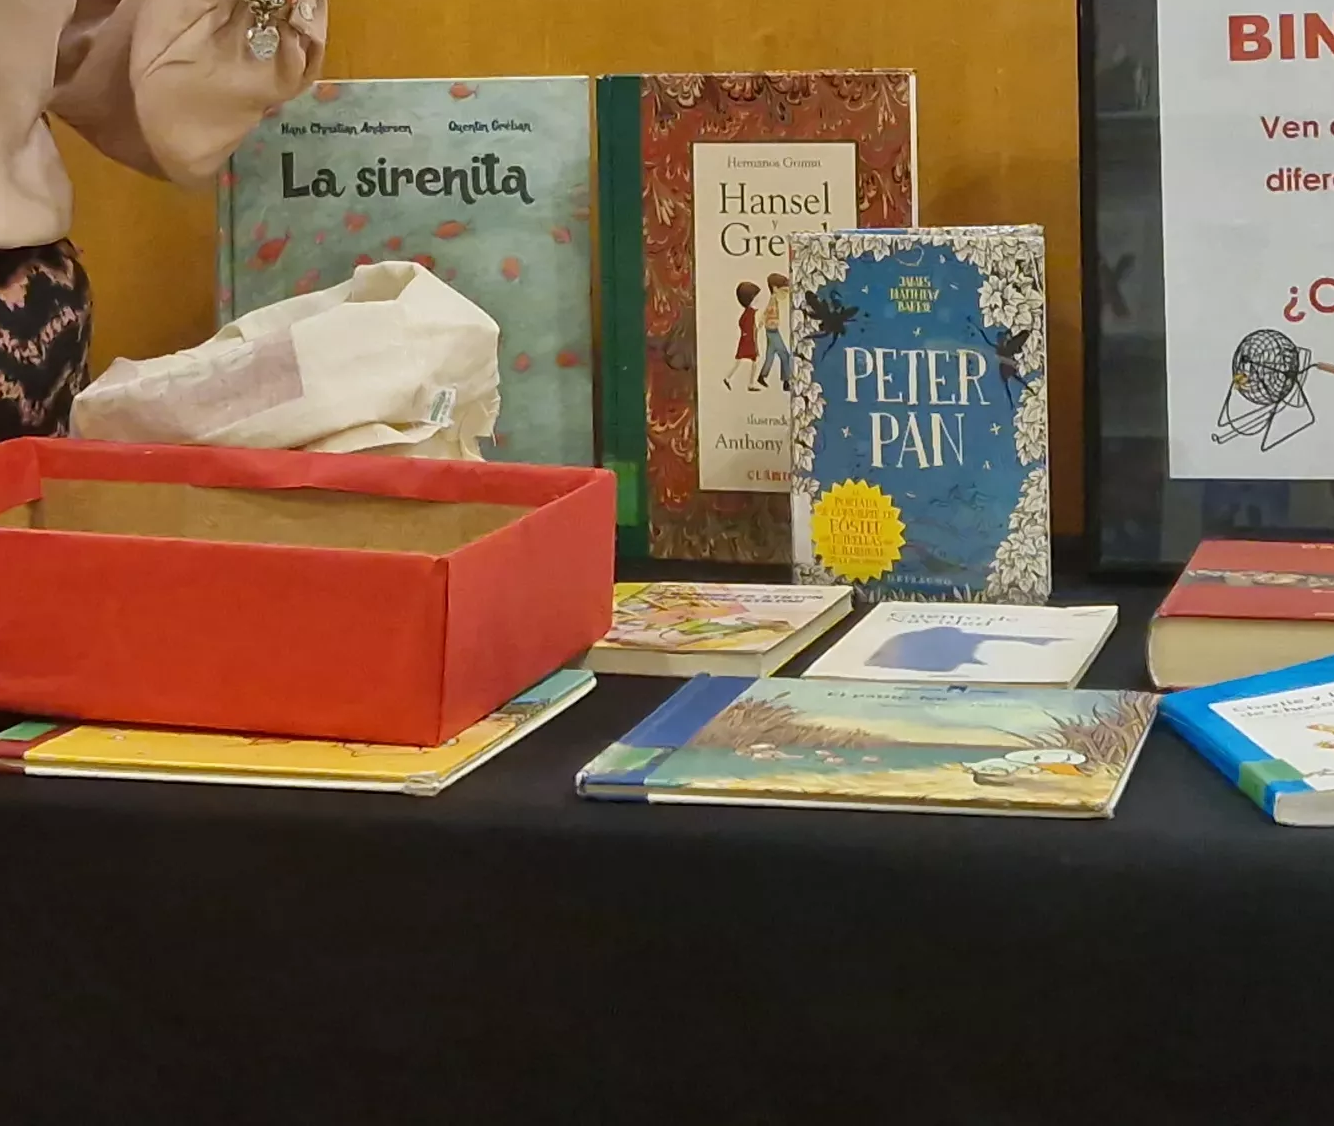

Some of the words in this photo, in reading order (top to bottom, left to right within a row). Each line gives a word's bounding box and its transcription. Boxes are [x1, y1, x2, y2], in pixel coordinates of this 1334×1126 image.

[281, 123, 307, 136] Hans
[310, 121, 358, 135] Christian
[361, 122, 413, 135] Andersen
[449, 120, 490, 133] Quentin
[1262, 119, 1319, 139] Ven
[727, 156, 780, 169] Hermanos
[782, 157, 822, 168] Grimm
[281, 152, 346, 199] La
[356, 152, 535, 205] sirenita
[719, 180, 832, 215] Hansel
[772, 219, 779, 231] y
[844, 347, 991, 406] PETER
[747, 414, 789, 426] ilustrad
[715, 433, 783, 456] Anthony
[869, 411, 965, 469] PAN
[1232, 697, 1304, 712] Charlie
[1311, 694, 1321, 702] y
